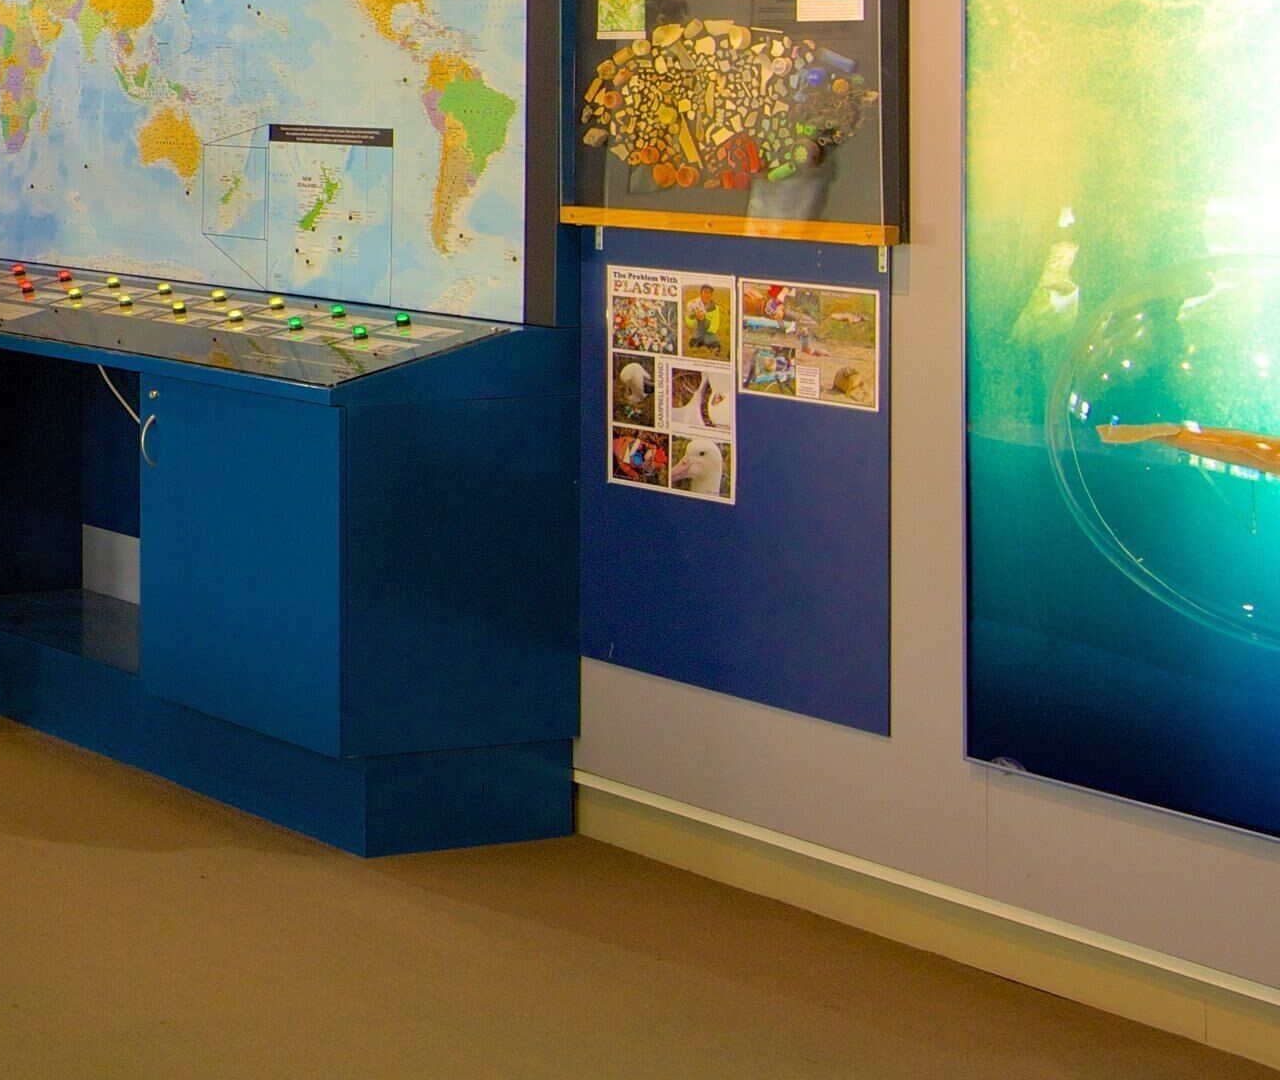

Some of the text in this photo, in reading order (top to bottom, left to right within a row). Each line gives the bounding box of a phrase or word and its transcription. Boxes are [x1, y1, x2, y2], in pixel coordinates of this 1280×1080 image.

[612, 271, 678, 284] The Problem With
[613, 279, 678, 297] PLASTIC
